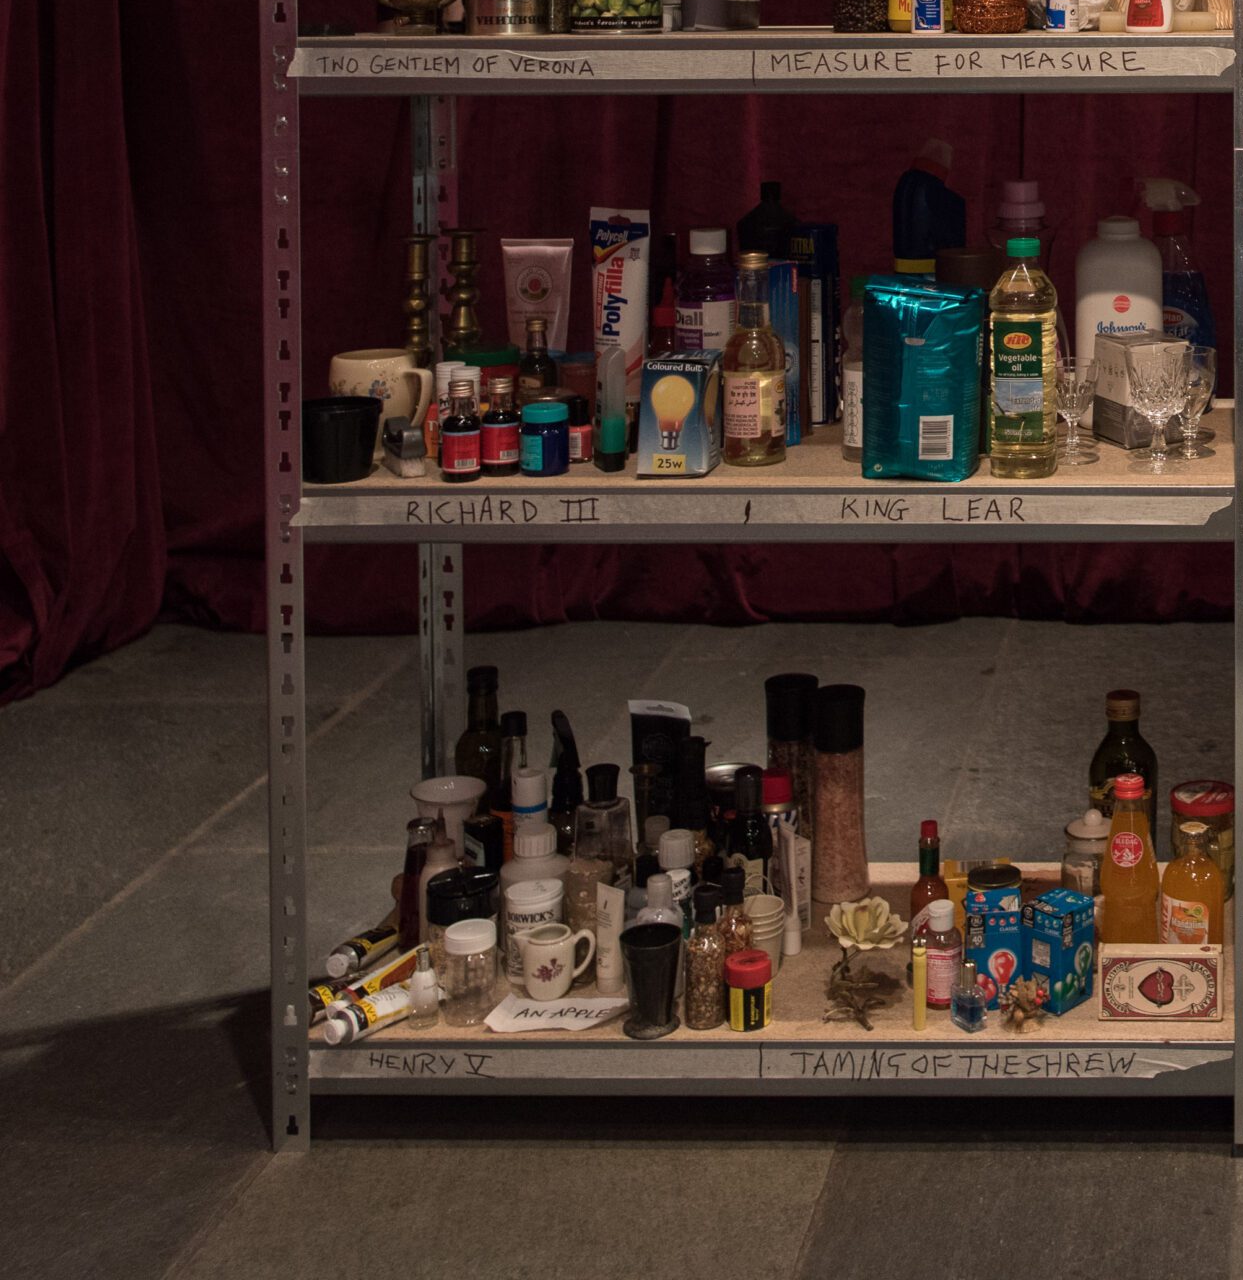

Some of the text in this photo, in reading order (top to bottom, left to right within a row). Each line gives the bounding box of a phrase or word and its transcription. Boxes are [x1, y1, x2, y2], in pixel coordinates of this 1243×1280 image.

[315, 54, 595, 76] TWO GENTLEM OF VERONA
[770, 50, 1146, 76] MEASURE FOR MEASURE
[596, 228, 629, 245] Polycell
[603, 257, 627, 337] Polyfilla
[1097, 320, 1147, 336] Johnson's
[998, 353, 1037, 363] Vegetable
[646, 361, 683, 372] Coloured
[1011, 362, 1022, 372] oil
[657, 458, 682, 469] 25w
[406, 495, 600, 526] RICHARD III
[841, 496, 1025, 523] KING LEAR
[998, 924, 1019, 933] CLASSIC
[971, 935, 983, 943] 40
[514, 1006, 612, 1021] AN APPLE
[368, 1052, 495, 1080] HENRY V
[790, 1049, 906, 1082] TAMING
[910, 1052, 953, 1076] OF
